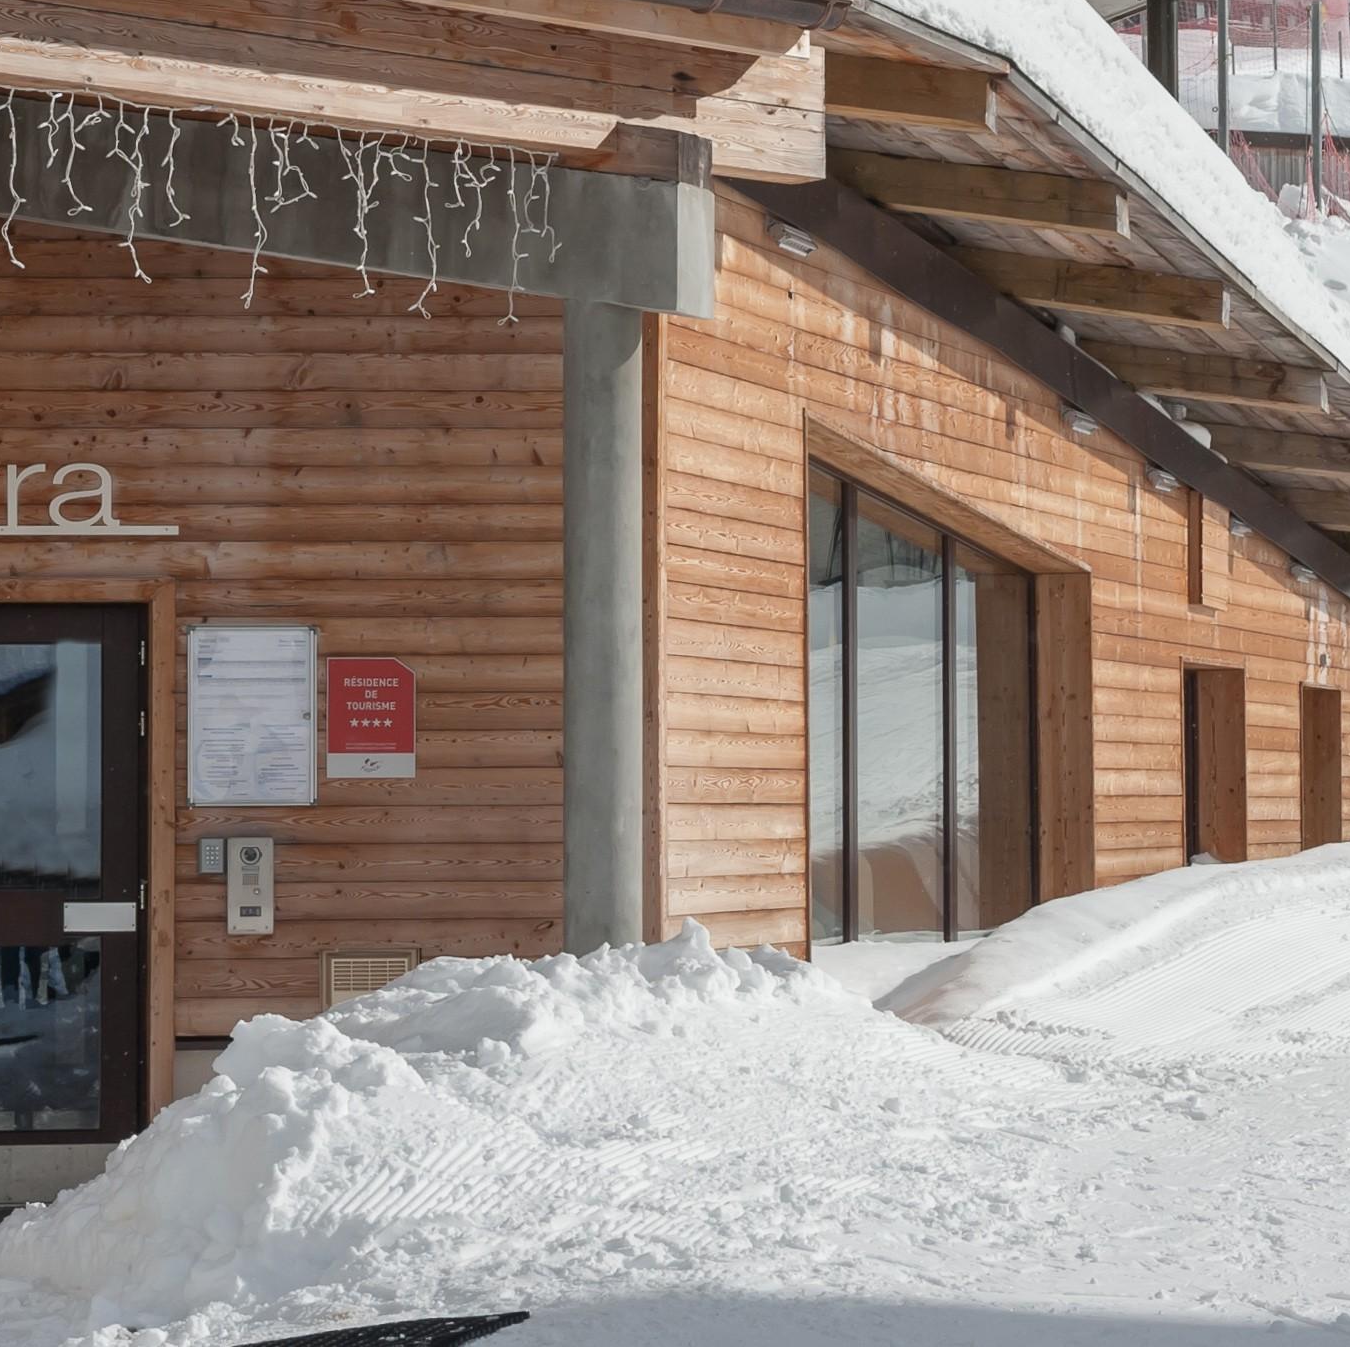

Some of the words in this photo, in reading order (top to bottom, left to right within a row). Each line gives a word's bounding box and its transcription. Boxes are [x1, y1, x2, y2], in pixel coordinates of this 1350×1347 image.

[344, 676, 399, 687] RÉSIDENCE
[365, 690, 378, 699] DE
[346, 701, 396, 710] TOURISME
